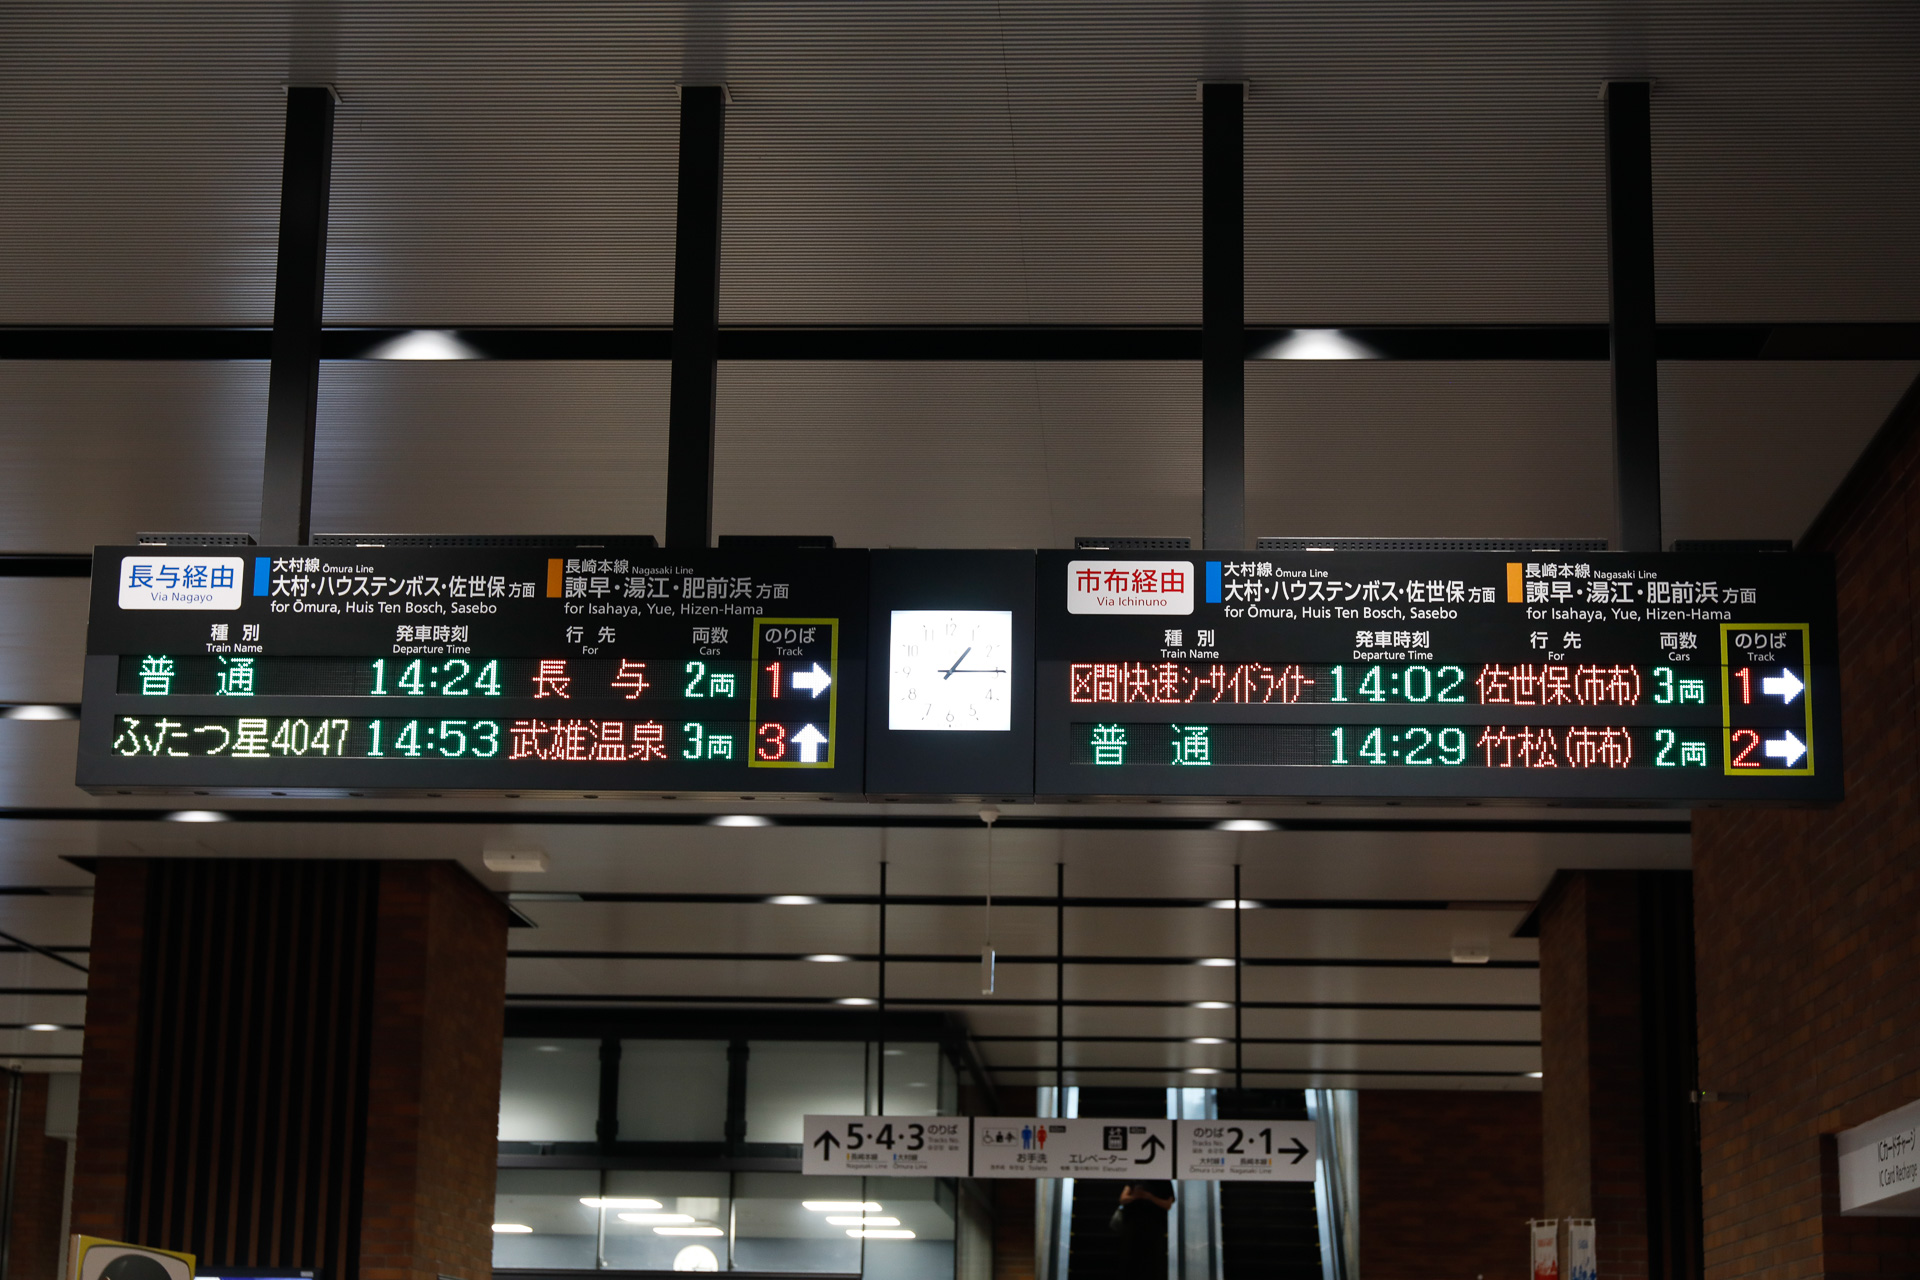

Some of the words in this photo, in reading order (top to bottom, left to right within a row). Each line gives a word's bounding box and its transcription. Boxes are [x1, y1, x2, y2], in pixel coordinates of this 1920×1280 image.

[272, 558, 320, 573] 大村線
[322, 563, 353, 573] Ōmura
[355, 564, 374, 573] Line
[565, 559, 629, 574] 長崎本線
[632, 566, 672, 576] Nagasaki
[676, 566, 693, 575] Line
[1224, 562, 1272, 577] 大村線
[1275, 567, 1307, 578] Ōmura
[1310, 569, 1328, 578] Line
[1525, 563, 1591, 578] 長崎本線
[1594, 570, 1636, 581] Nagasaki
[1639, 570, 1657, 579] Line
[128, 564, 234, 589] 長与経由
[1076, 568, 1185, 594] 市布経由
[271, 575, 505, 598] 大村・ハウステンボス・佐世保
[508, 582, 535, 598] 方面
[565, 577, 752, 599] 諫早・湯江・肥前浜
[756, 583, 789, 599] 方面
[1224, 580, 1465, 602] 大村・ハウステンボス・佐世保
[1468, 588, 1495, 603] 方面
[1526, 581, 1718, 604] 諫早・湯江・肥前浜
[1723, 588, 1756, 604] 方面
[151, 592, 169, 602] Via
[172, 592, 213, 604] Nagayo
[1097, 597, 1115, 607] Via
[1118, 597, 1167, 607] Ichinuno
[271, 601, 290, 612] for
[292, 599, 341, 614] Ōmura,
[346, 602, 374, 613] Huis
[378, 602, 402, 613] Ten
[405, 602, 447, 615] Bosch,
[451, 603, 497, 613] Sasebo
[564, 602, 586, 614] for
[589, 602, 642, 618] Isahaya,
[646, 603, 676, 617] Yue,
[681, 604, 763, 615] Hizen-Hama
[1224, 606, 1244, 617] for
[1248, 604, 1297, 620] Ōmura,
[1302, 607, 1332, 618] Huis
[1335, 607, 1360, 618] Ten
[1363, 607, 1406, 621] Bosch,
[1410, 608, 1457, 619] Sasebo
[1526, 608, 1548, 619] for
[1551, 608, 1606, 623] Isahaya,
[1611, 608, 1642, 622] Yue,
[1646, 608, 1731, 621] Hizen-Hama
[396, 625, 468, 642] 発車時刻
[692, 627, 728, 644] 両数
[765, 628, 816, 644] のりば
[1355, 631, 1429, 648] 発車時刻
[1735, 633, 1787, 649] のりば
[206, 643, 230, 652] Train
[233, 643, 262, 653] Name
[1660, 633, 1698, 650] 両数
[393, 645, 443, 655] Departure
[446, 645, 471, 654] Time
[582, 646, 598, 655] For
[699, 647, 721, 656] Cars
[777, 647, 803, 656] Track
[1161, 649, 1186, 659] Train
[1189, 649, 1219, 659] Name
[1353, 651, 1405, 661] Departure
[1408, 651, 1433, 660] Time
[1548, 652, 1564, 661] For
[1668, 652, 1690, 661] Cars
[1747, 652, 1775, 662] Track
[371, 659, 500, 695] 14:24
[685, 661, 734, 698] 2両
[766, 662, 779, 698] 1
[1331, 665, 1464, 702] 14:02
[1476, 664, 1639, 705] 佐世保(市布)
[1654, 667, 1704, 704] 3両
[1735, 668, 1749, 704] 1
[908, 688, 917, 700] 8
[985, 689, 992, 700] 4
[925, 704, 931, 716] 7
[946, 710, 954, 722] 6
[969, 704, 976, 716] 5
[114, 718, 348, 758] ふたつ星4047
[368, 720, 499, 757] 14:53
[509, 719, 667, 761] 武雄温泉
[684, 722, 732, 759] 3両
[758, 723, 785, 760] 3
[1332, 727, 1465, 764] 14:29
[1477, 726, 1631, 768] 竹松(市布)
[1656, 729, 1706, 766] 2両
[1732, 729, 1759, 767] 2
[928, 1125, 958, 1135] のりば
[1194, 1128, 1224, 1137] のりば
[1017, 1153, 1047, 1163] お手洗
[1069, 1154, 1127, 1163] エレベーター
[1885, 1165, 1895, 1186] Card
[1896, 1162, 1918, 1183] Recharge
